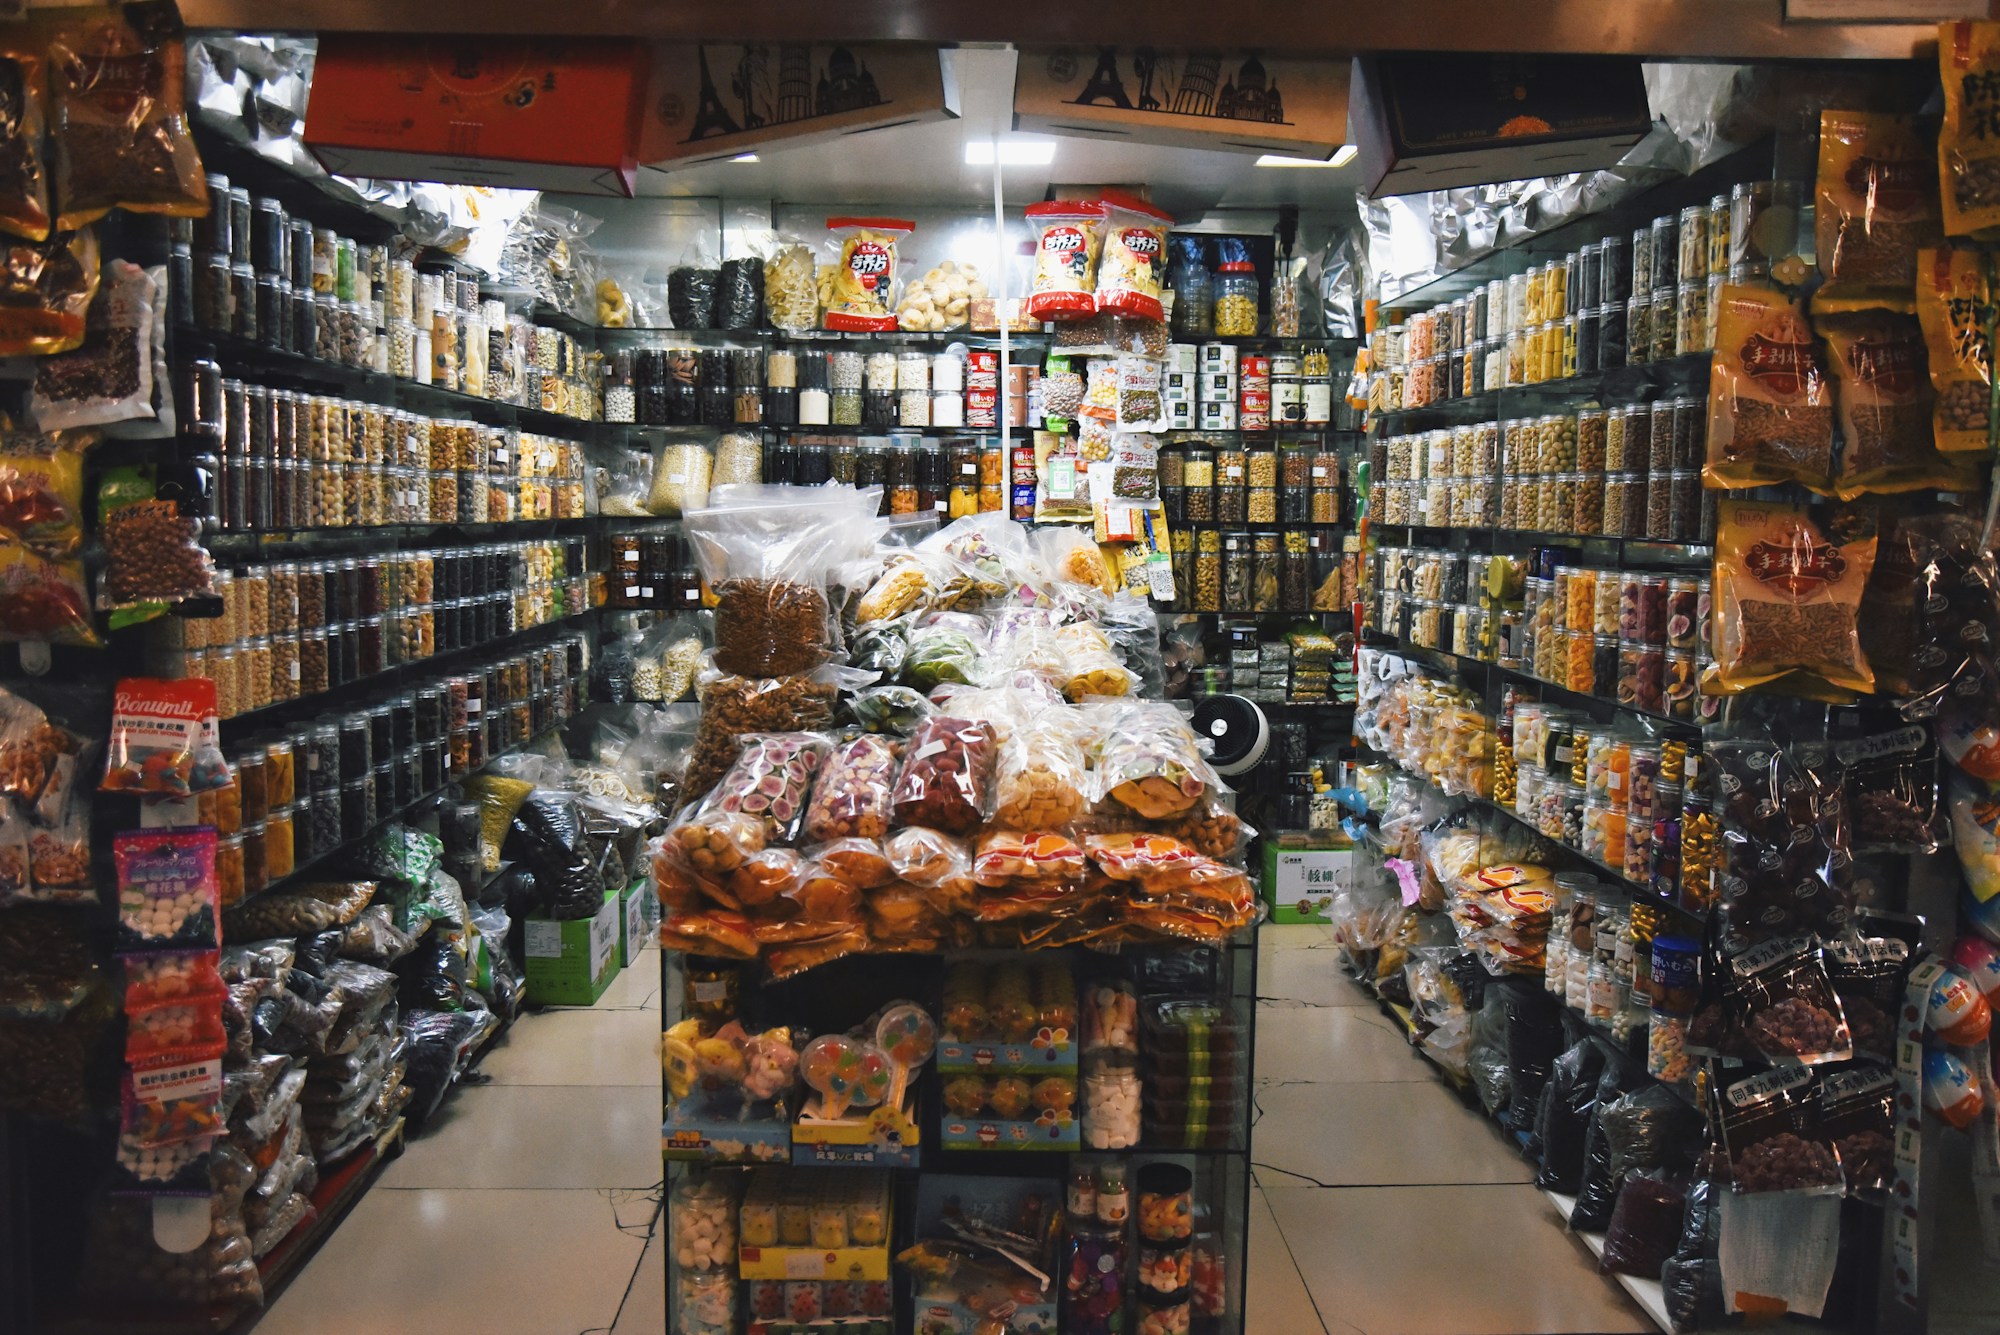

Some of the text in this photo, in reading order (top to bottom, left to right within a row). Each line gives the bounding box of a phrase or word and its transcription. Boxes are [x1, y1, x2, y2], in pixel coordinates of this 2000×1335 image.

[1307, 869, 1340, 883] 核桃
[1732, 1066, 1808, 1102] 同享九制话梅
